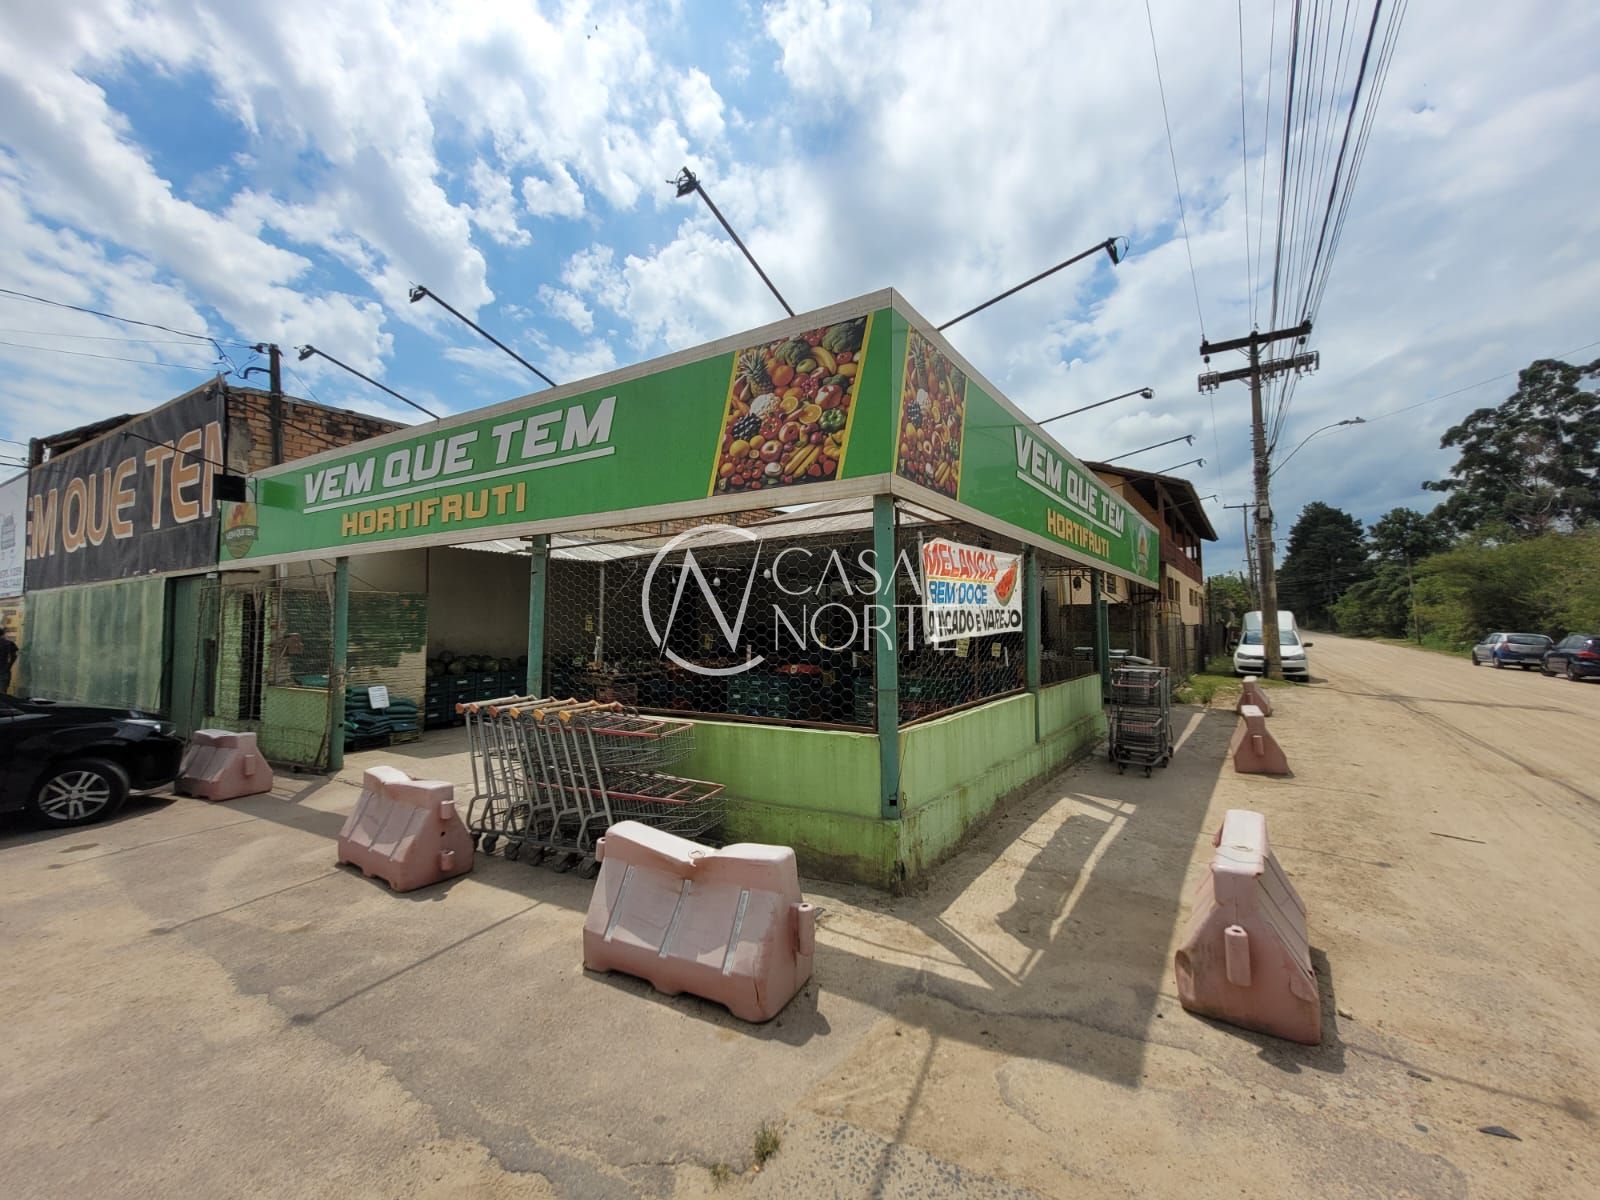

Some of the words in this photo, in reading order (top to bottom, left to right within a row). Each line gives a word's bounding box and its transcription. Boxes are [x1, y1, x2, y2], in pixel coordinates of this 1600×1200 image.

[305, 458, 375, 503] VEM
[382, 430, 479, 488] QUE
[491, 396, 617, 465] TEM
[62, 456, 137, 554] QUE
[1014, 426, 1062, 492] VEM
[1067, 470, 1097, 515] QUE
[1101, 496, 1124, 532] TEM
[341, 481, 527, 538] HORTIFRUTI
[1048, 508, 1109, 558] HORTIFRUTI
[923, 543, 998, 581] MELANCIA
[929, 581, 956, 604] BEM
[958, 582, 988, 605] DOCE
[975, 615, 981, 631] E
[981, 609, 1022, 631] VAREJO
